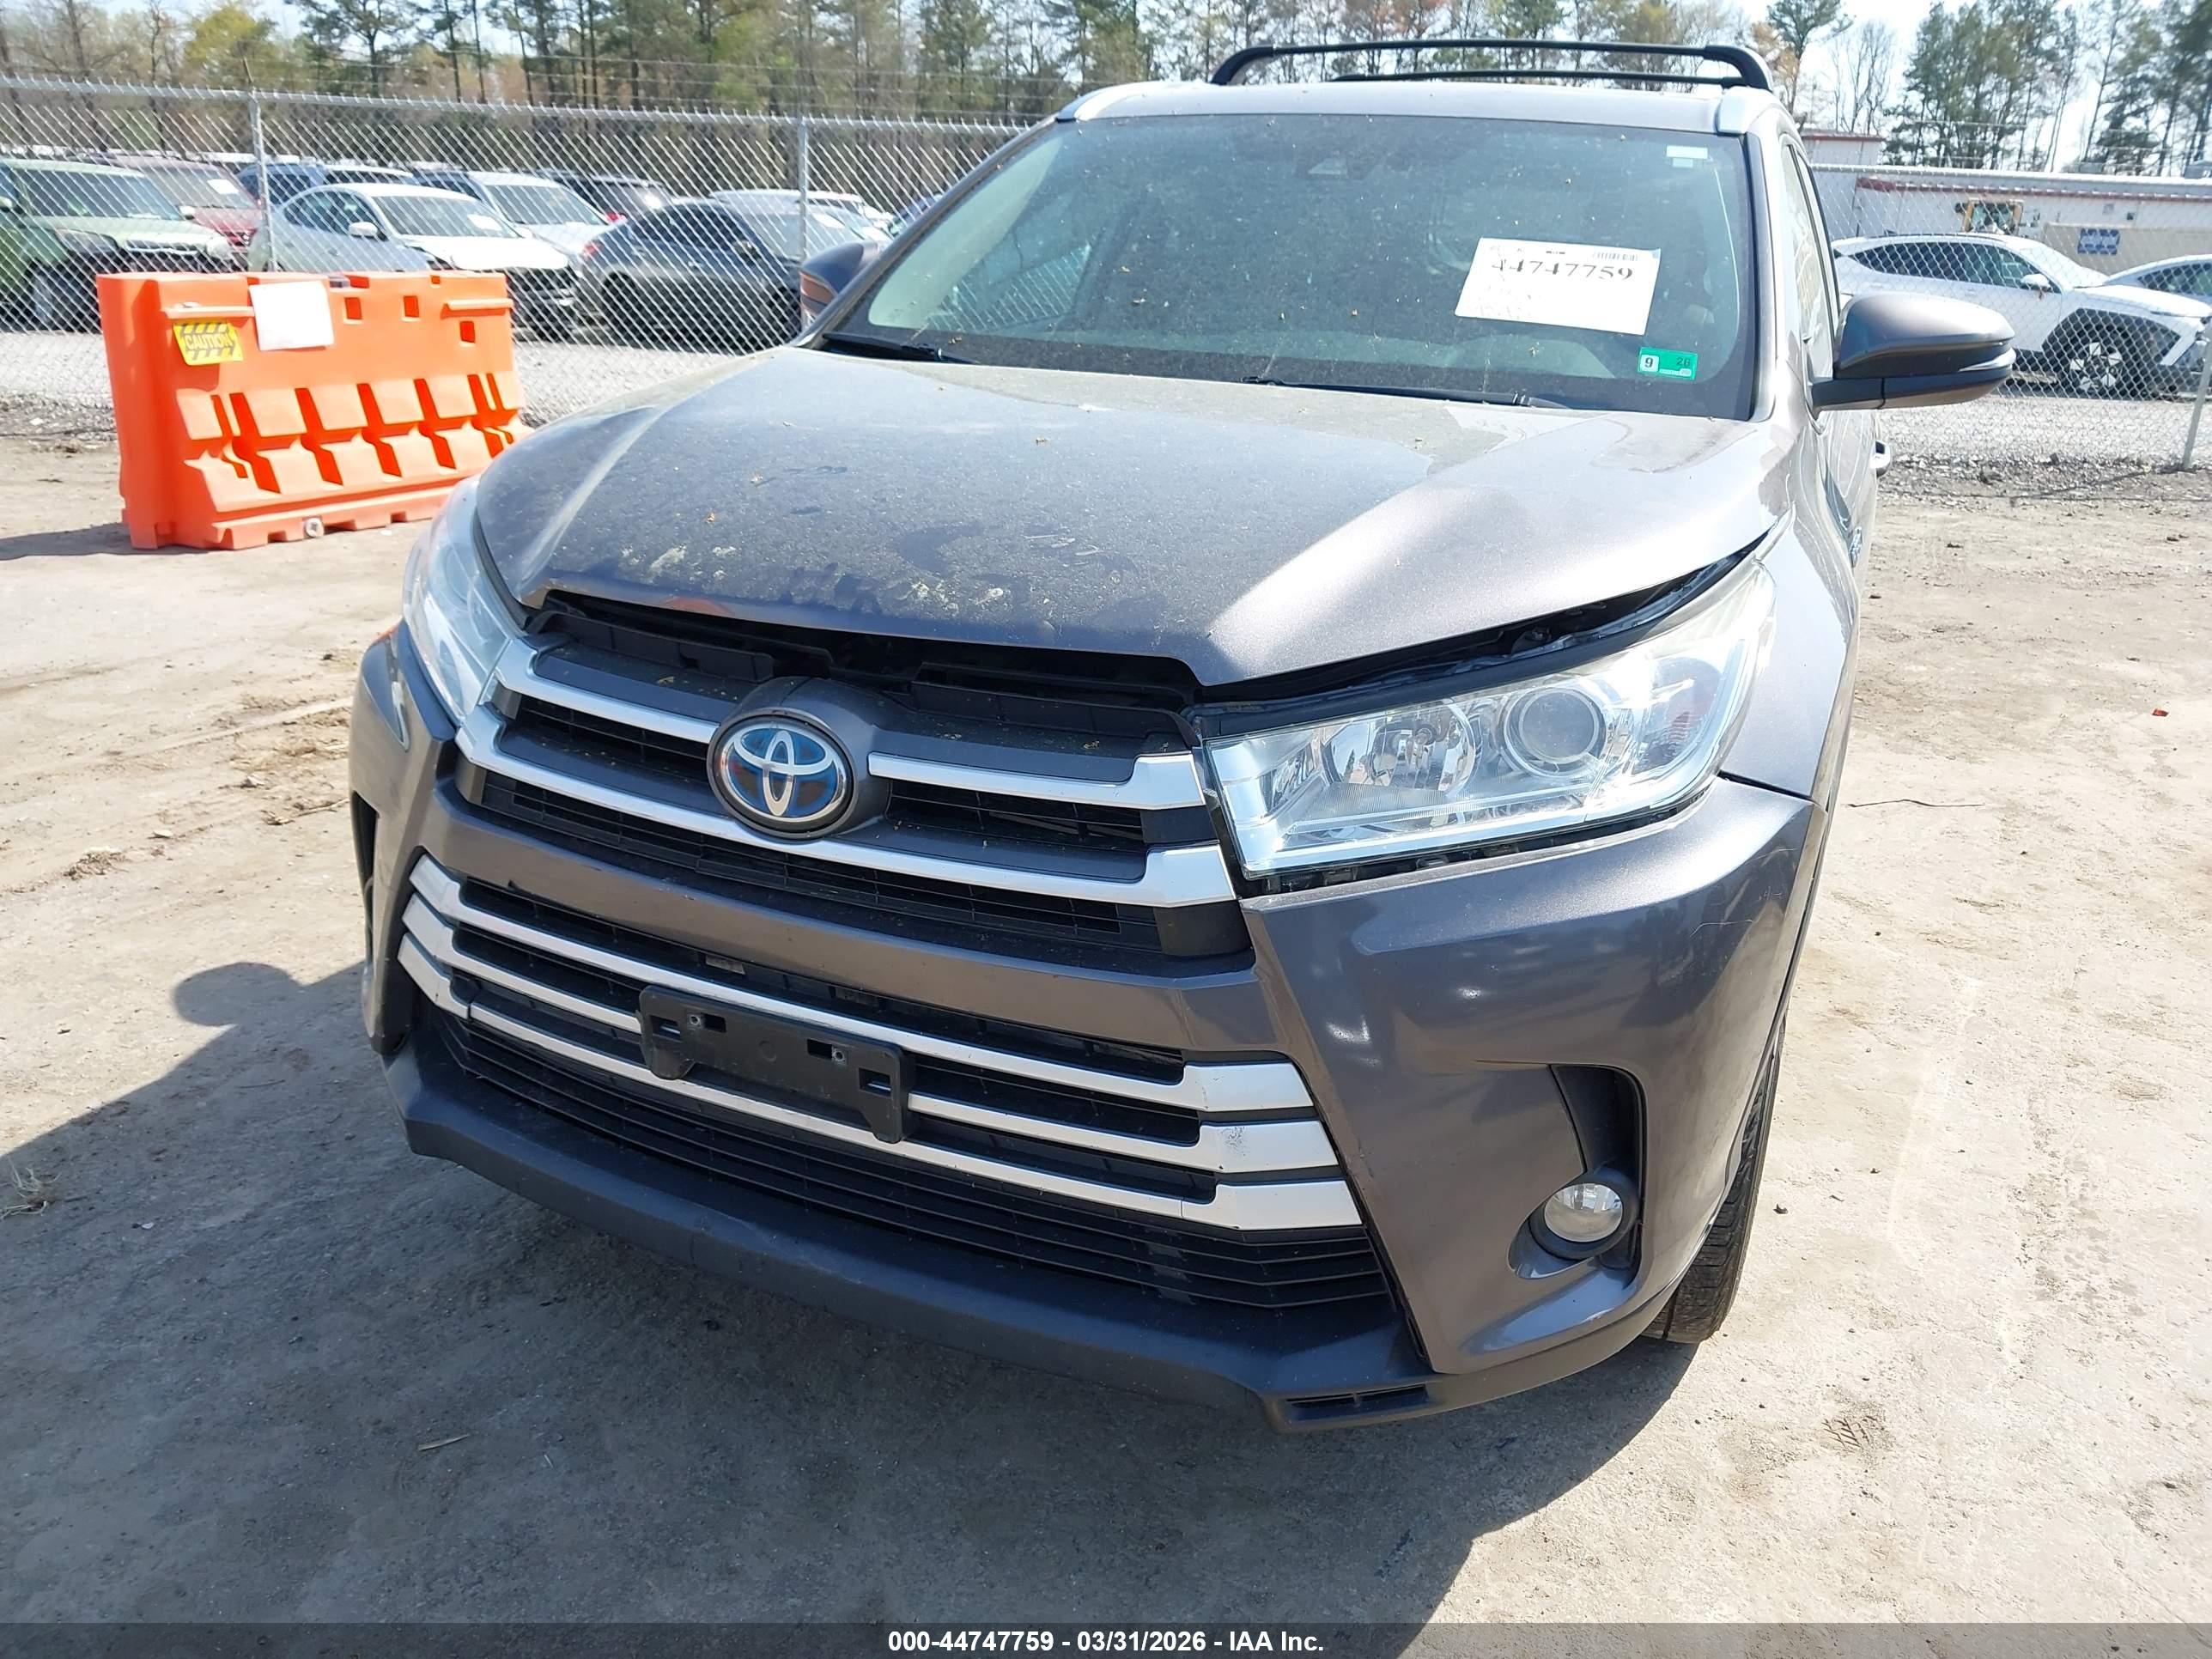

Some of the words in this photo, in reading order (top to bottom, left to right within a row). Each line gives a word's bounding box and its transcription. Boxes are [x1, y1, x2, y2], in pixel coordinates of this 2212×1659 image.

[1492, 258, 1633, 280] 44747759
[185, 332, 233, 350] CAUTION
[1644, 356, 1654, 368] 9
